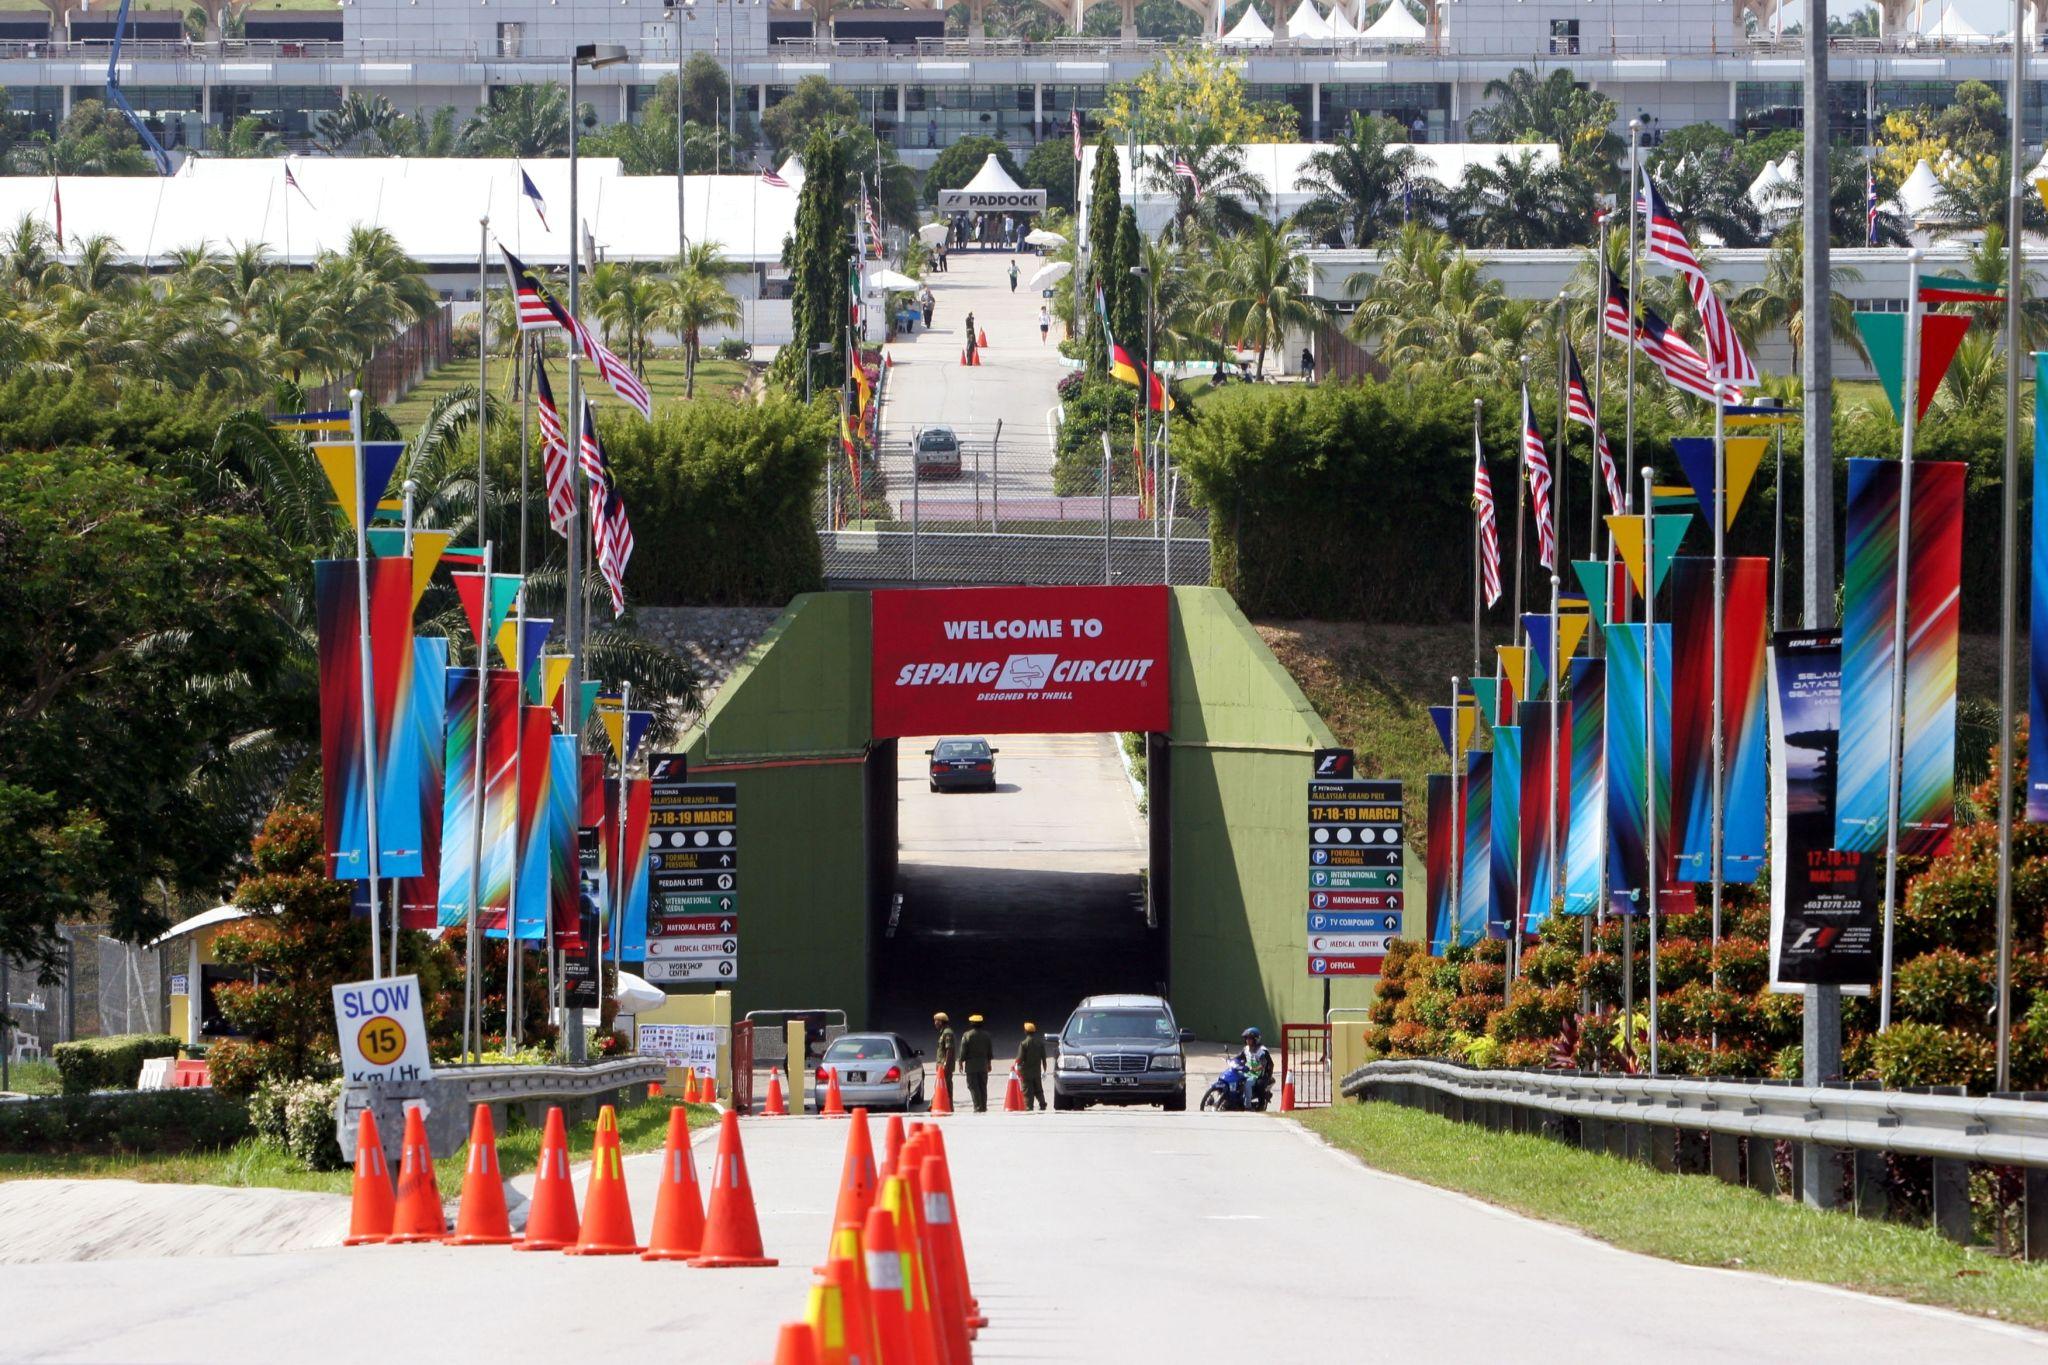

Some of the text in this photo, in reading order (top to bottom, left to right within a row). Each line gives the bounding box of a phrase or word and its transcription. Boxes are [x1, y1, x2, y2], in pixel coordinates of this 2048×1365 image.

[969, 195, 1038, 206] PADDOCK
[944, 618, 1103, 640] WELCOME TO
[895, 659, 1154, 686] SEPANG CIRCUIT
[1798, 672, 1842, 680] SELAMA
[976, 691, 1073, 701] DESIGNED TO THRILL
[694, 811, 733, 823] MARCH
[1312, 807, 1399, 820] 17-18-19 MARCH
[1317, 852, 1325, 863] P
[1316, 873, 1325, 884] P
[666, 897, 711, 905] INTERNATIONAL
[1318, 895, 1326, 906] P
[1804, 901, 1821, 909] +603
[698, 923, 715, 931] PRESS
[1315, 916, 1324, 928] P
[1316, 960, 1355, 971] P OFFICIAL
[343, 984, 409, 1018] SLOW
[366, 1028, 396, 1054] 15
[400, 1064, 420, 1081] Hr
